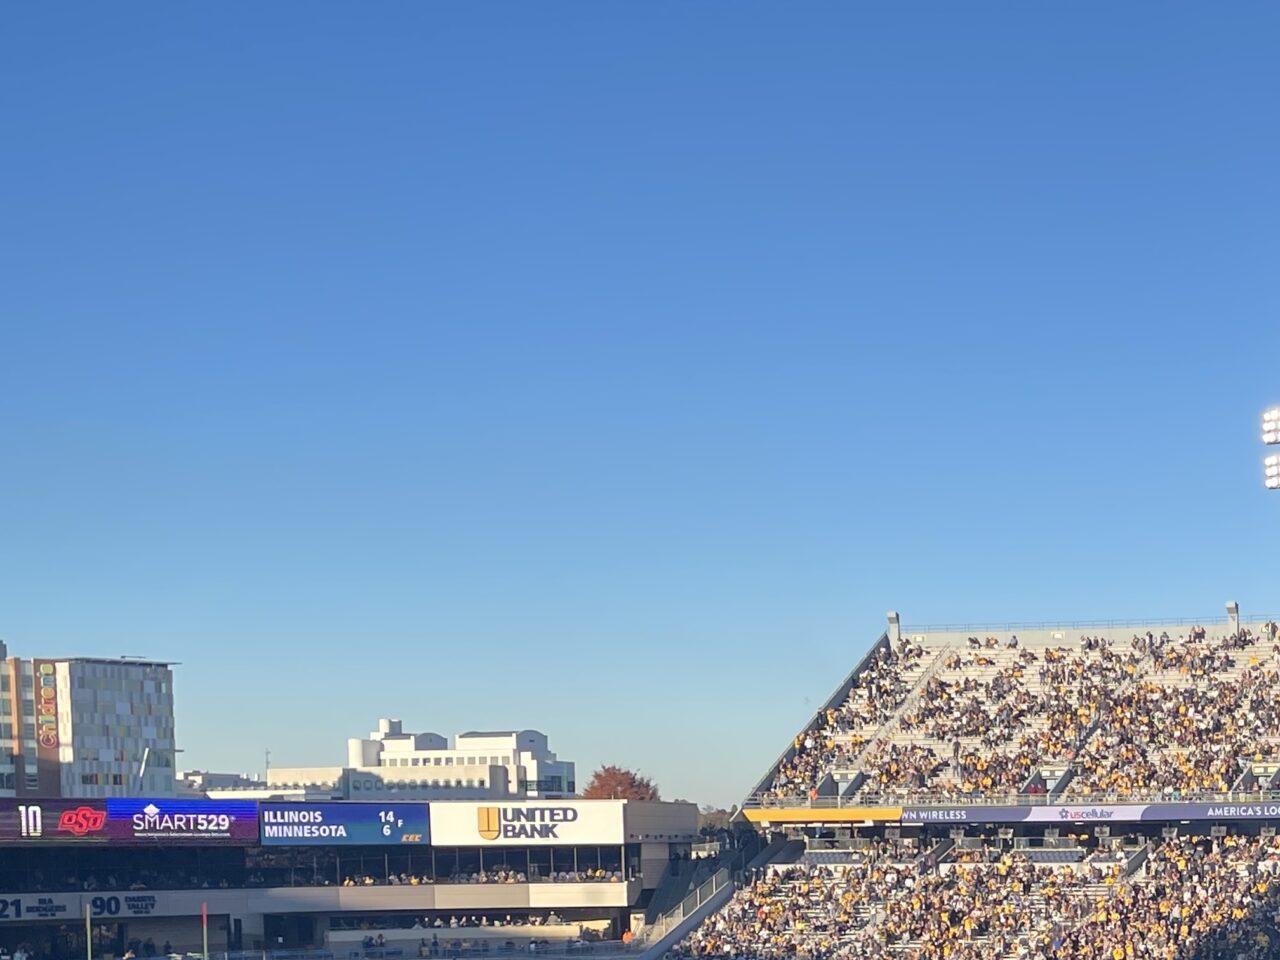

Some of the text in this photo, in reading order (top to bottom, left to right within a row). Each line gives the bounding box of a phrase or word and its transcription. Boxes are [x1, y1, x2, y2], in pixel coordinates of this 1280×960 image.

[264, 810, 322, 823] ILLINOIS
[378, 810, 395, 824] 14
[502, 807, 578, 822] UNITED
[919, 809, 967, 820] WIRELESS
[1207, 805, 1261, 817] AMERICA'S
[19, 805, 43, 837] 10
[264, 825, 347, 838] MINNESOTA
[382, 824, 391, 836] 6
[503, 823, 559, 839] BANK
[0, 898, 21, 919] 21
[91, 896, 121, 916] 90
